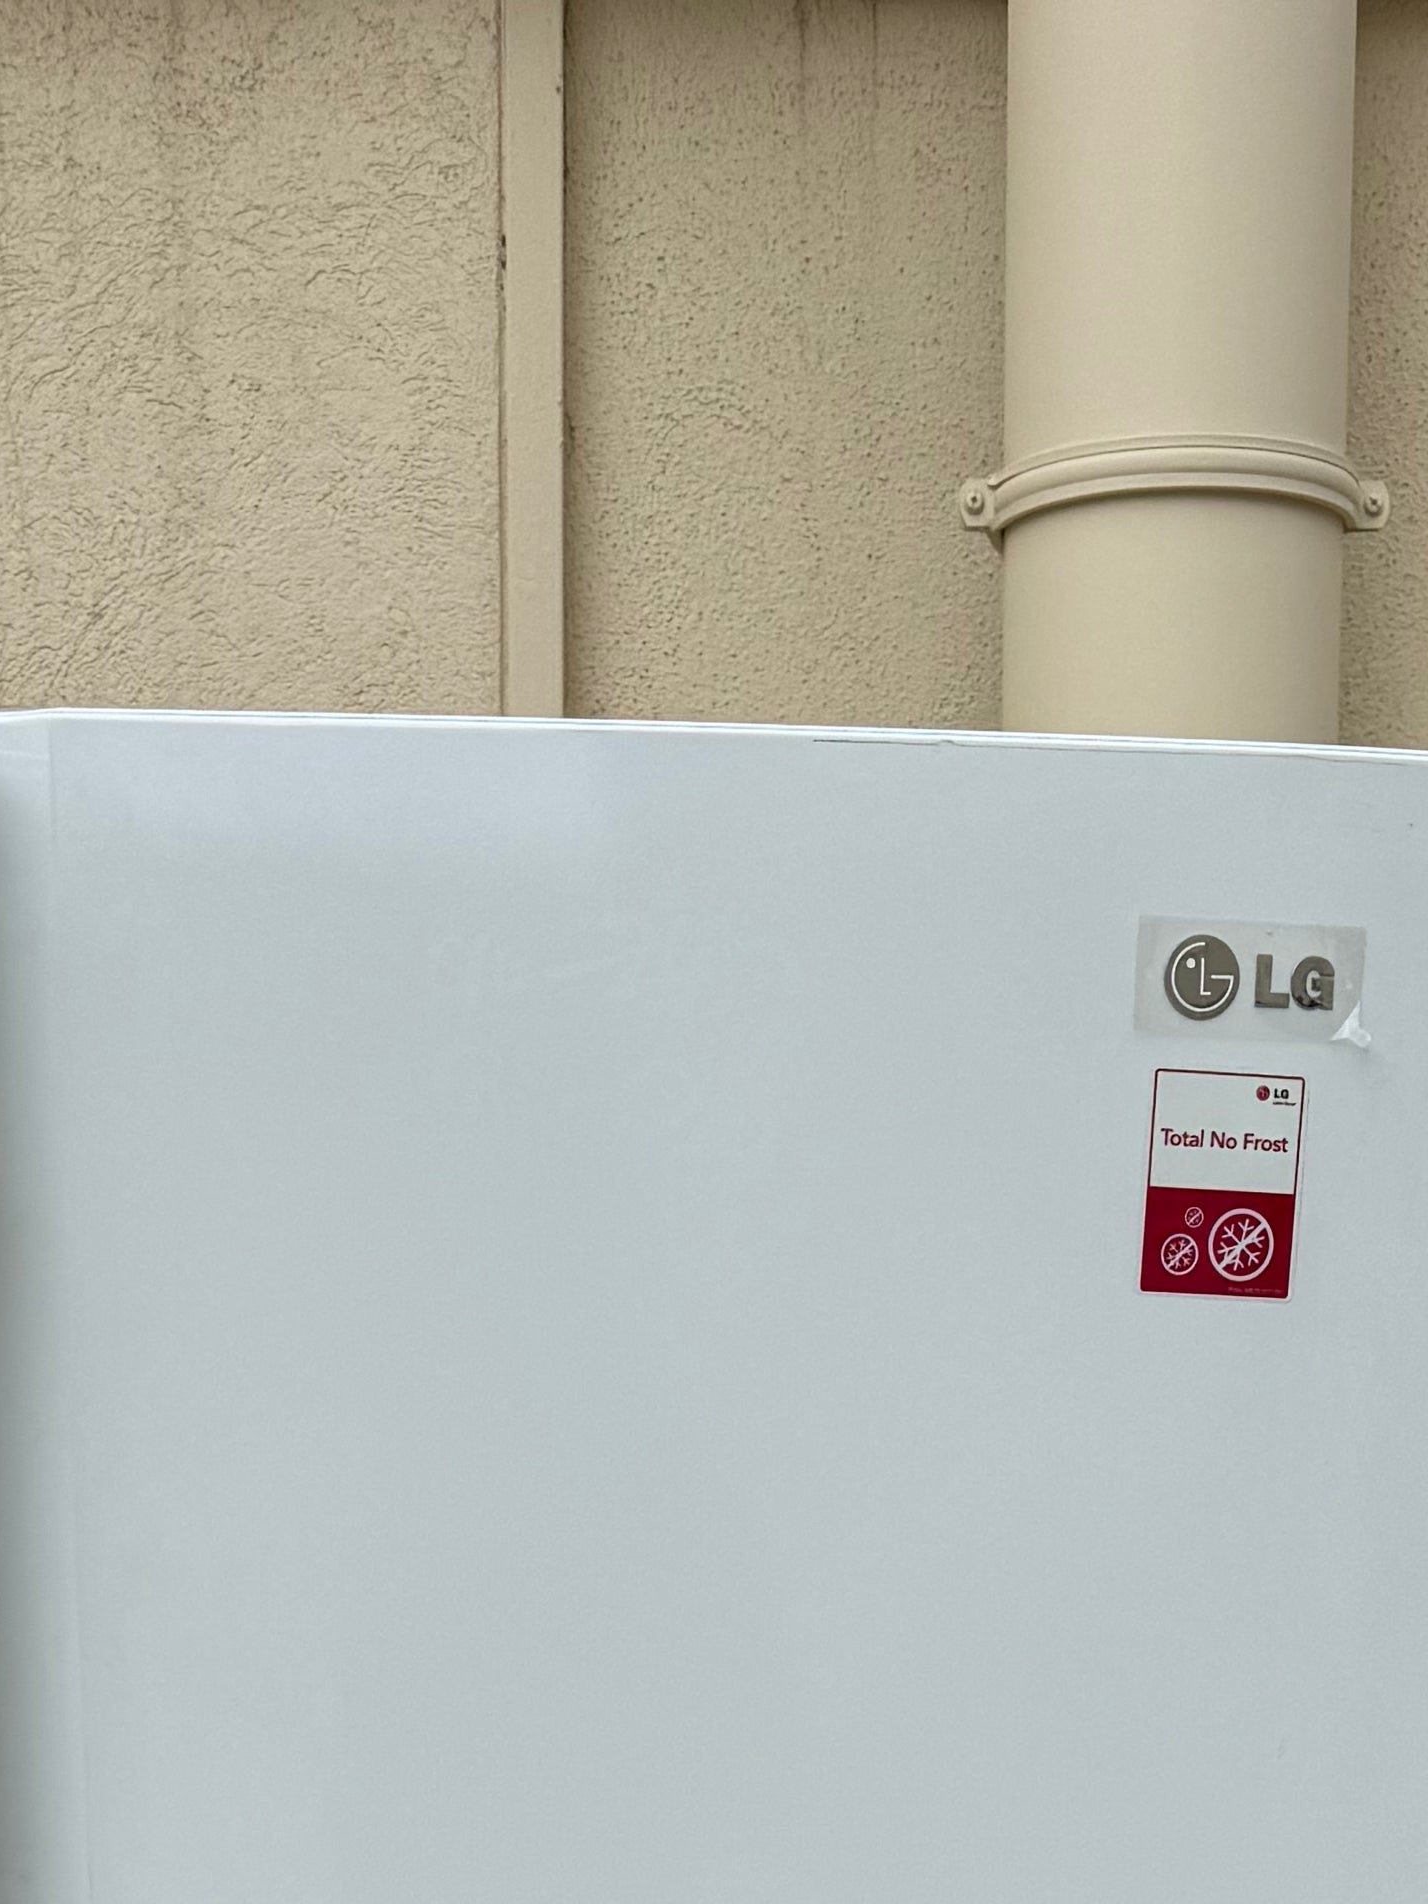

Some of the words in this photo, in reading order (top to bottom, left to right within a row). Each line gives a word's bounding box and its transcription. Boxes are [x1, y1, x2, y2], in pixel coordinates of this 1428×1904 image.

[1254, 953, 1336, 1011] LG
[1273, 1088, 1290, 1100] LG
[1160, 1127, 1205, 1149] Total
[1210, 1131, 1238, 1151] No
[1243, 1132, 1289, 1153] Frost
